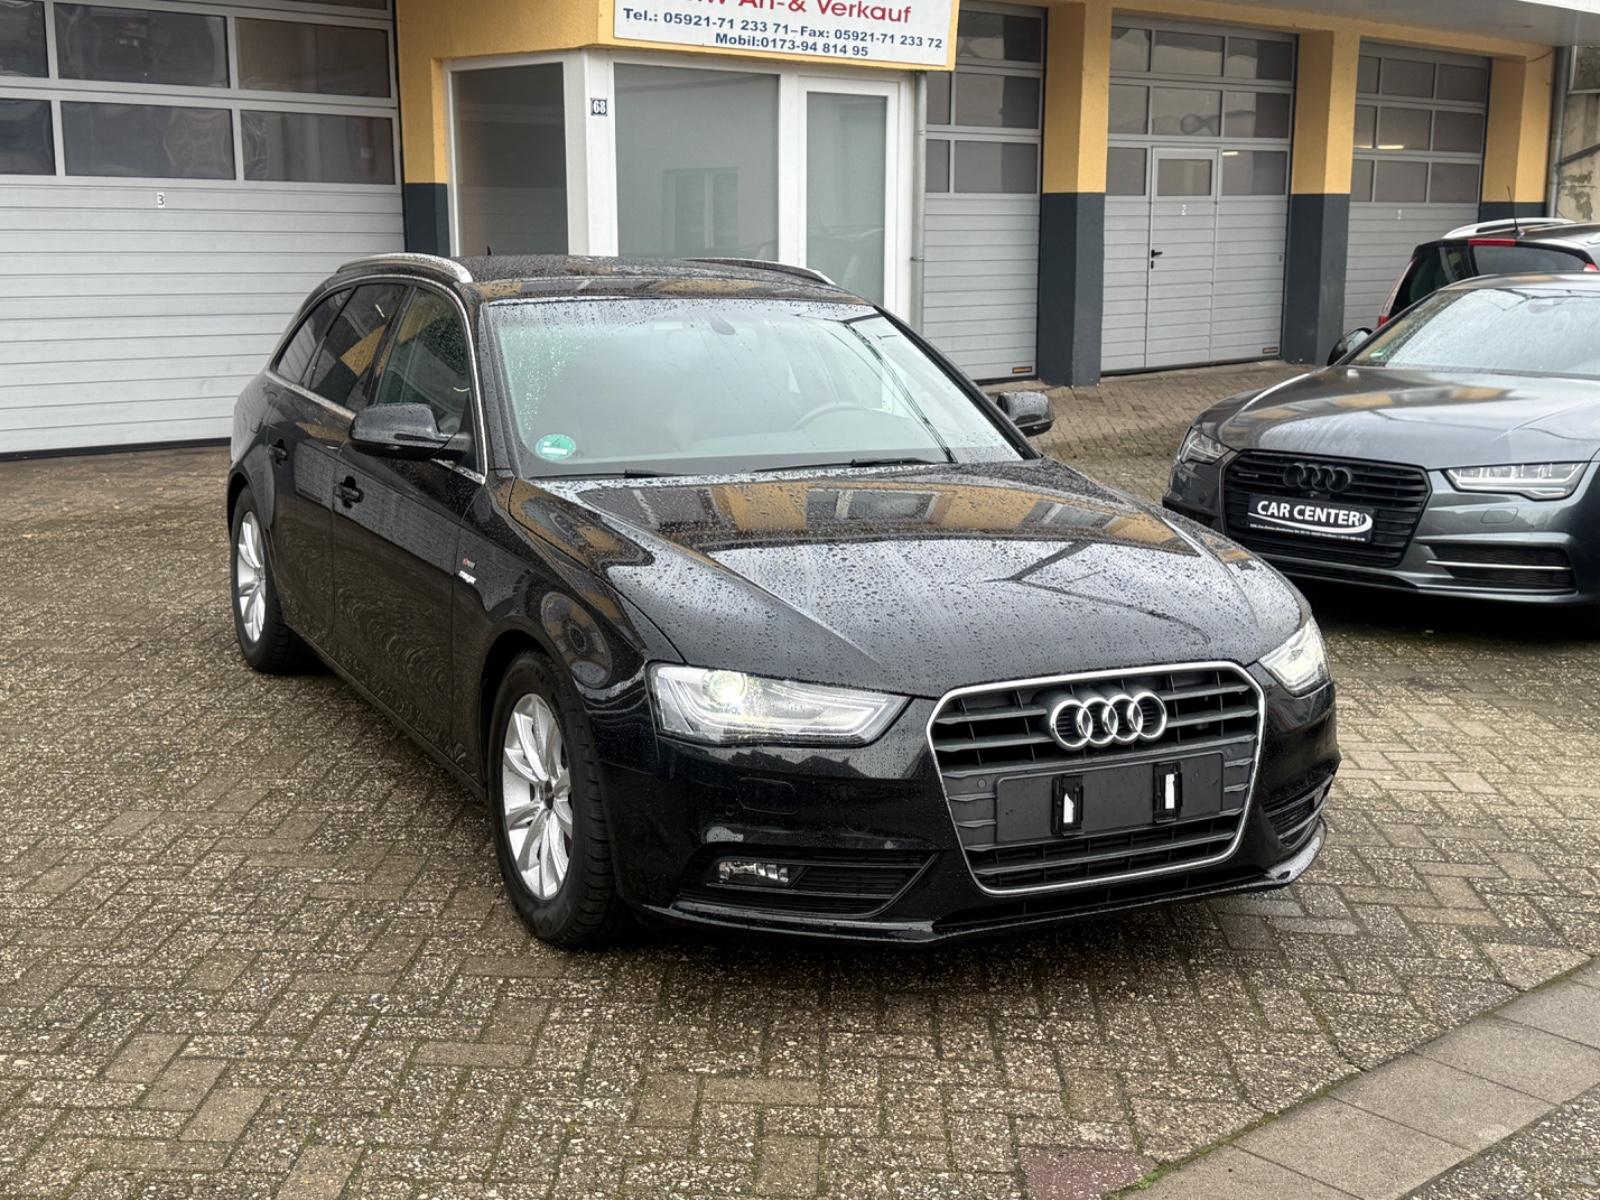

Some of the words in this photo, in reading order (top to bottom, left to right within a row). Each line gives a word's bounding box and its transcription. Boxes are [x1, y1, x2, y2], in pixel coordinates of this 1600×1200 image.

[816, 0, 912, 23] Verkauf
[623, 8, 658, 22] Tel.:
[663, 12, 734, 29] 05921-71
[740, 19, 768, 33] 233
[834, 29, 895, 44] 05921-71
[900, 35, 923, 47] 233
[927, 37, 943, 49] 72
[822, 42, 848, 55] 814
[852, 45, 869, 57] 95
[593, 100, 606, 114] 68
[1257, 501, 1290, 518] CAR
[1293, 505, 1360, 526] CENTER
